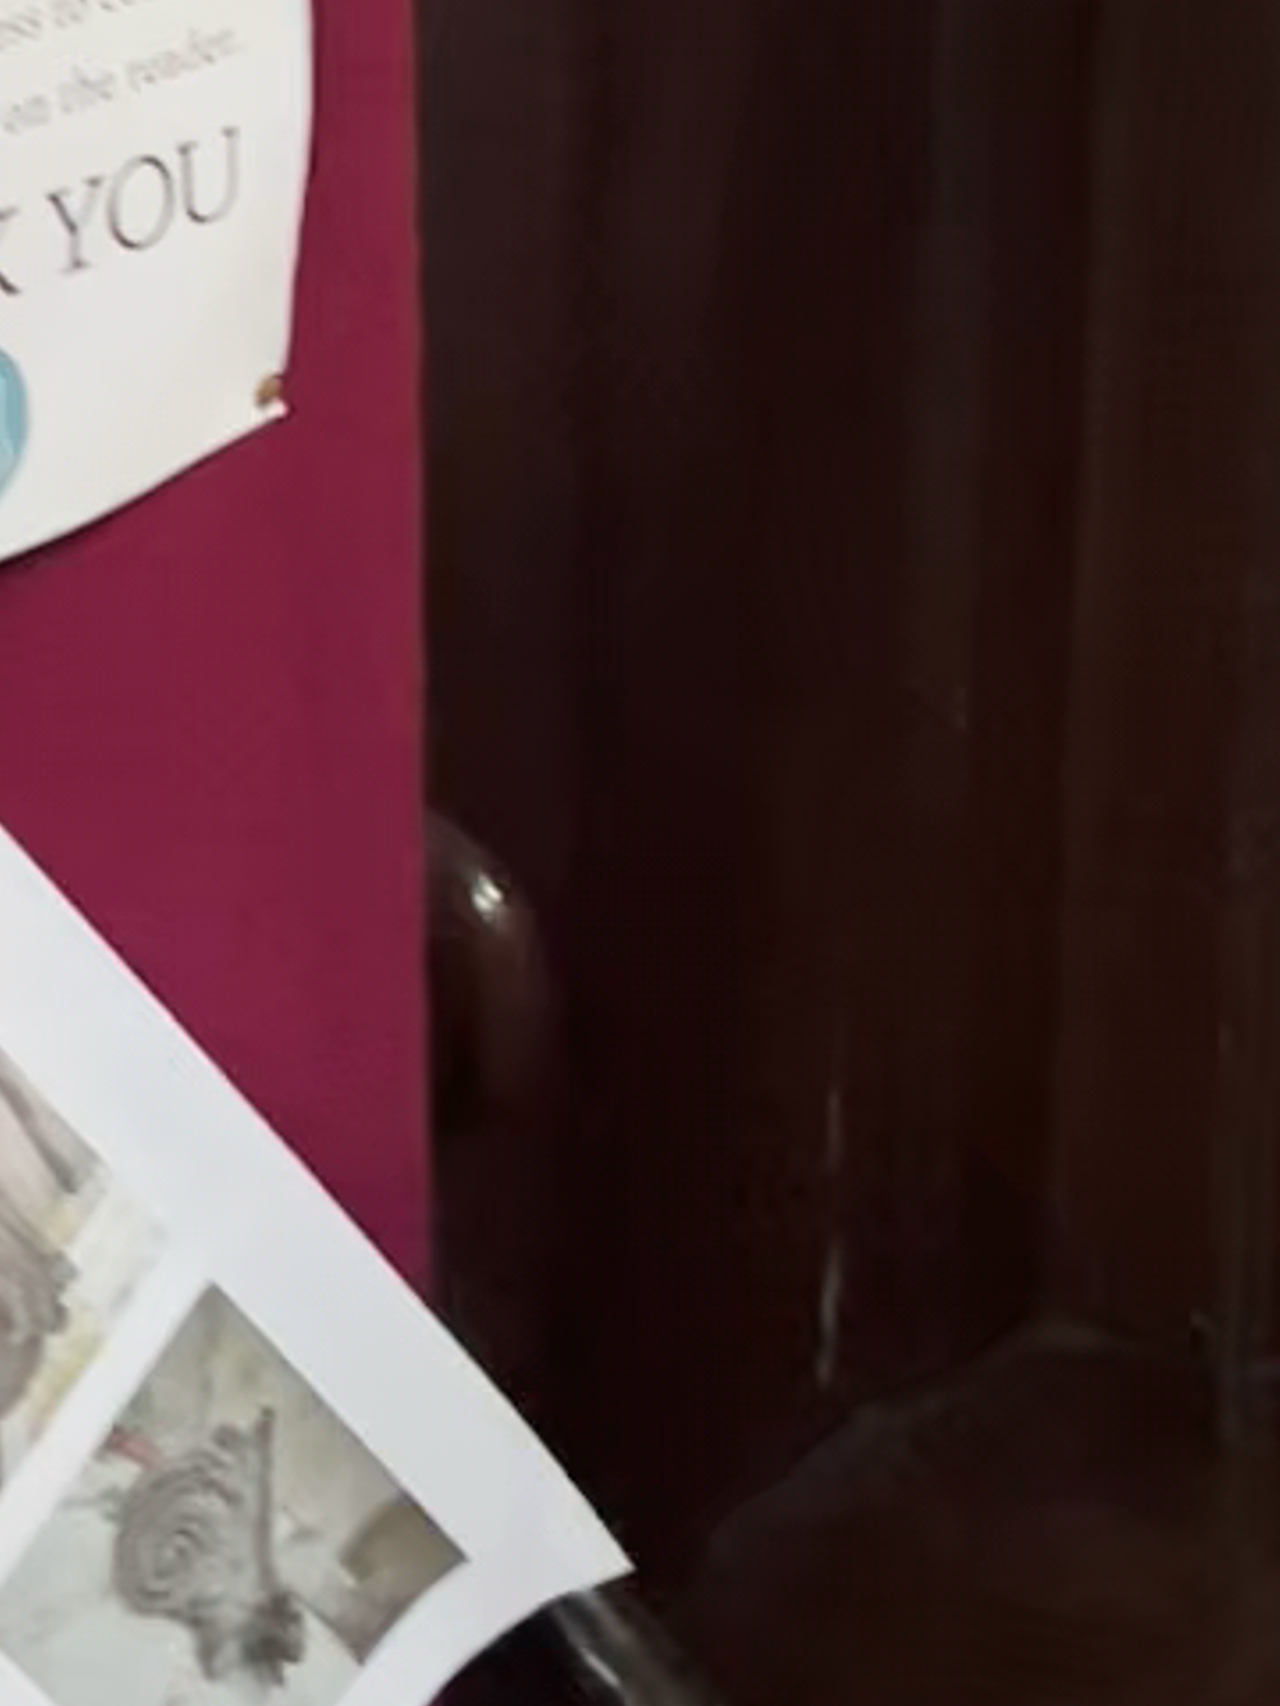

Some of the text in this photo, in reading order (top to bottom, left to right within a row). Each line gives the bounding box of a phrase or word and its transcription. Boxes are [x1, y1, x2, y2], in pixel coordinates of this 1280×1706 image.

[1, 94, 51, 133] on
[59, 66, 117, 116] the
[46, 126, 245, 278] YOU
